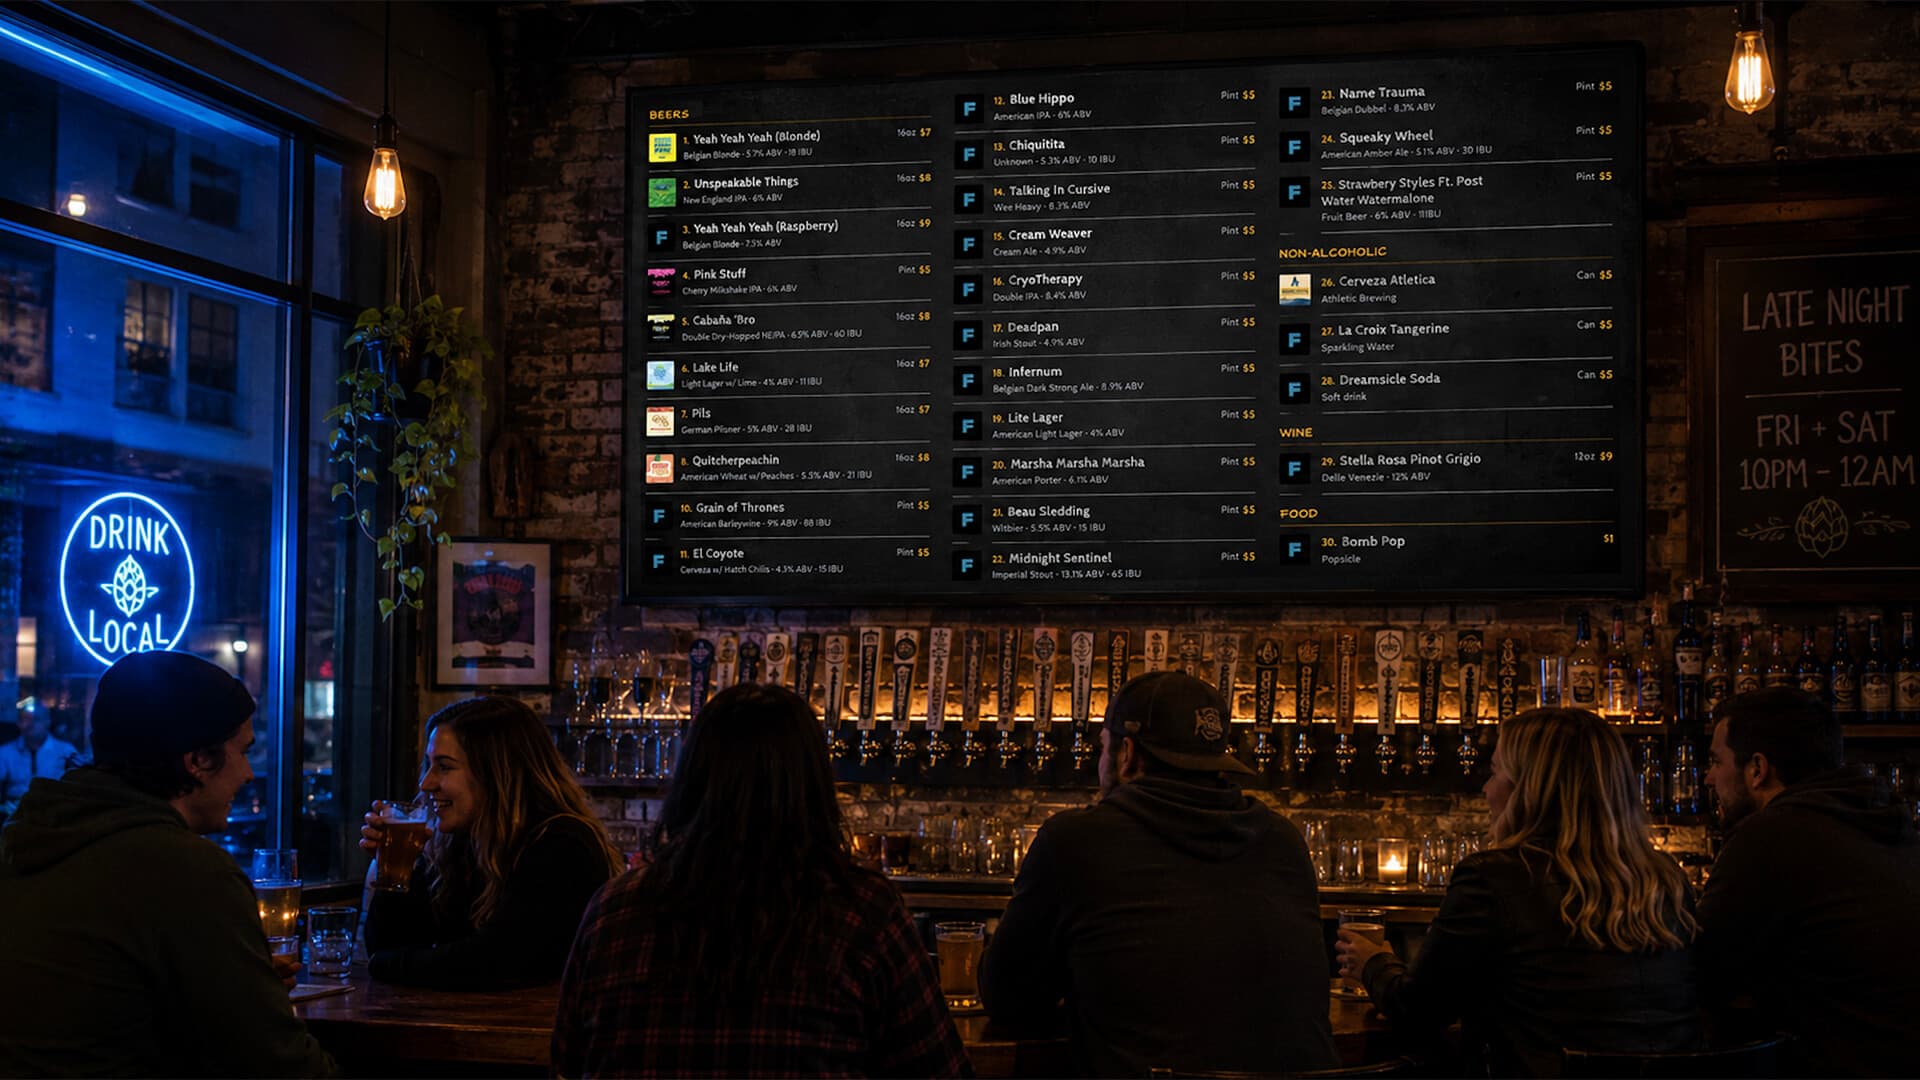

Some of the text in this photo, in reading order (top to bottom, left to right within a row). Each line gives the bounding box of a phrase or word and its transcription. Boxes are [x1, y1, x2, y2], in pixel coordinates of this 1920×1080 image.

[1220, 89, 1255, 100] Pint $5
[1339, 87, 1375, 98] Name
[1378, 86, 1425, 97] Trauma
[1010, 92, 1035, 104] Blue
[1038, 92, 1074, 106] Hippo
[649, 109, 689, 120] BEERS
[693, 133, 718, 144] Yeah
[720, 132, 745, 143] Yeah
[747, 131, 772, 142] Yeah
[775, 129, 820, 143] (Blonde)
[897, 127, 931, 137] 16oz $7
[1339, 130, 1391, 146] Squeaky
[1394, 128, 1433, 141] Wheel
[1009, 138, 1065, 153] Chiquitita
[896, 172, 931, 182] 16oz $8
[1575, 171, 1612, 180] Pint $5
[694, 176, 762, 191] Unspeakable
[764, 175, 799, 188] Things
[1338, 178, 1396, 191] Strawbery
[1398, 175, 1435, 190] Styles
[1438, 176, 1453, 187] Ft.
[1456, 175, 1483, 186] Post
[1009, 184, 1050, 198] Talking
[1053, 184, 1064, 195] In
[1067, 182, 1110, 194] Cursive
[683, 192, 783, 206] New England IPA 6% ABV
[1320, 192, 1434, 206] Water Watermalone
[693, 222, 718, 234] Yeah
[721, 221, 745, 233] Yeah
[748, 221, 773, 232] Yeah
[775, 218, 838, 233] (Raspberry)
[896, 218, 931, 227] 16oz $9
[1008, 229, 1046, 240] Cream
[1048, 229, 1092, 239] Weaver
[1279, 246, 1387, 258] NON-ALCOHOLIC
[694, 268, 716, 279] Pink
[719, 267, 746, 279] Stuff
[1338, 275, 1387, 286] Cerveza
[1389, 273, 1436, 285] Atletica
[1008, 272, 1083, 288] CryoTherapy
[1320, 293, 1397, 303] Athletic Brewing
[1742, 285, 1911, 331] LATE NIGHT
[692, 314, 732, 325] Cabaña
[733, 314, 755, 324] 'Bro
[1007, 321, 1059, 335] Deadpan
[1338, 325, 1352, 336] La
[1354, 323, 1386, 335] Croix
[1389, 322, 1449, 336] Tangerine
[992, 337, 1085, 348] Irish Stout 4.9% ABV
[1321, 342, 1394, 354] Sparkling Water
[1779, 339, 1864, 377] BITES
[692, 361, 717, 372] Lake
[719, 361, 739, 372] Life
[1008, 365, 1062, 377] Infernum
[1339, 372, 1406, 385] Dreamsicle
[1409, 372, 1440, 384] Soda
[1577, 369, 1613, 379] Can $5
[992, 381, 1144, 395] Belgian Dark Strong Ale 8.9% ABV
[1321, 391, 1367, 401] Soft drink
[691, 407, 711, 418] Pils
[1008, 411, 1029, 423] Lite
[1032, 412, 1063, 425] Lager
[1279, 427, 1313, 437] WINE
[1756, 410, 1896, 448] FRI + SAT
[692, 454, 779, 468] Quitcherpeachin
[1010, 457, 1053, 469] Marsha
[1055, 456, 1098, 468] Marsha
[1101, 455, 1145, 467] Marsha
[1339, 453, 1374, 465] Stella
[1377, 454, 1407, 465] Rosa
[1410, 453, 1442, 464] Pinot
[1445, 452, 1481, 466] Grigio
[1574, 451, 1613, 461] 12oz $9
[1739, 458, 1808, 491] 10PM
[1840, 455, 1916, 488] 12AM
[695, 501, 724, 513] Grain
[726, 501, 738, 512] of
[740, 501, 785, 512] Thrones
[1007, 506, 1036, 517] Beau
[1038, 505, 1090, 518] Sledding
[1279, 508, 1318, 518] FOOD
[90, 514, 170, 555] DRINK
[1603, 533, 1613, 543] $1
[1341, 535, 1378, 547] Bomb
[1381, 535, 1405, 549] Pop
[692, 547, 703, 558] El
[705, 548, 744, 561] Coyote
[1008, 551, 1060, 566] Midnight
[1063, 551, 1112, 563] Sentinel
[1221, 551, 1255, 561] Pint $5
[1321, 554, 1361, 565] Popsicle
[89, 609, 170, 654] LOCAL
